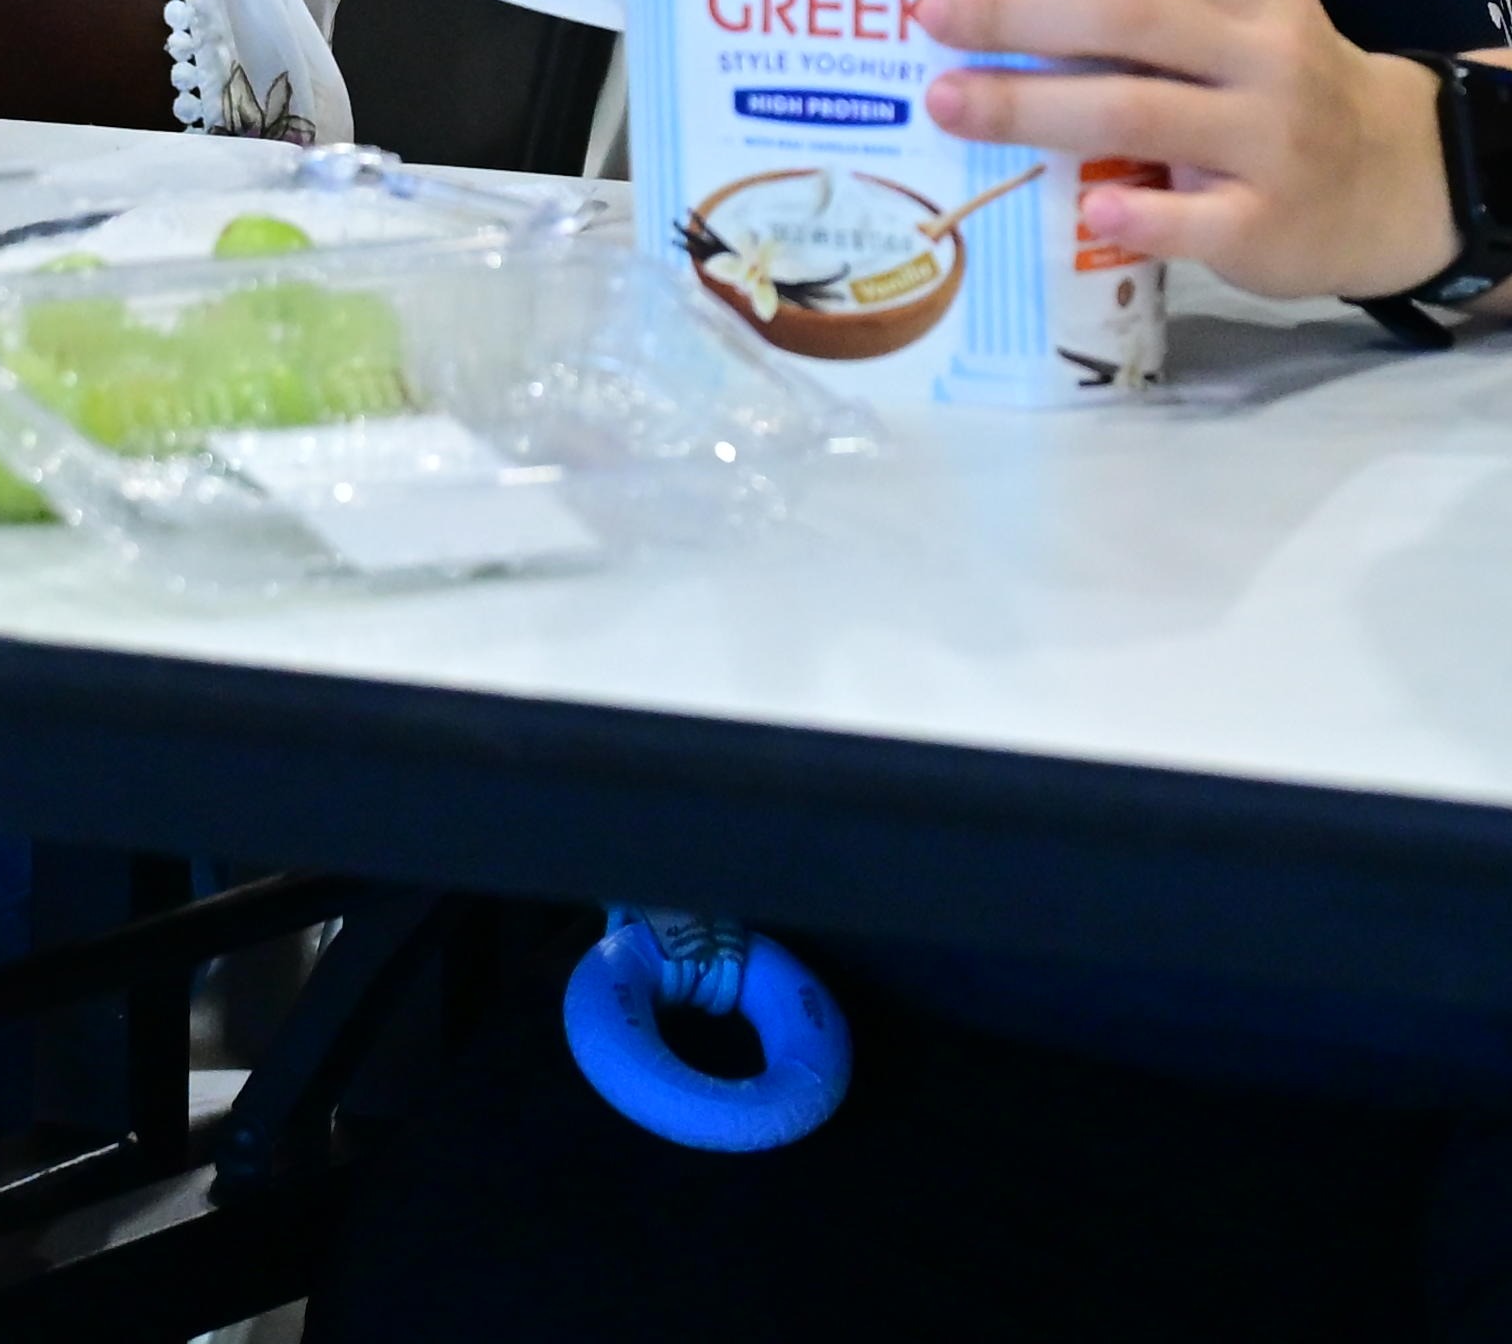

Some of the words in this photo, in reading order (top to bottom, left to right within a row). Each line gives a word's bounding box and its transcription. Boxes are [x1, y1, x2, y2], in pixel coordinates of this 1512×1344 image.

[718, 51, 788, 74] STYLE
[800, 52, 928, 82] YOGHURT
[746, 93, 804, 116] HIGH
[805, 96, 897, 123] PROTEIN
